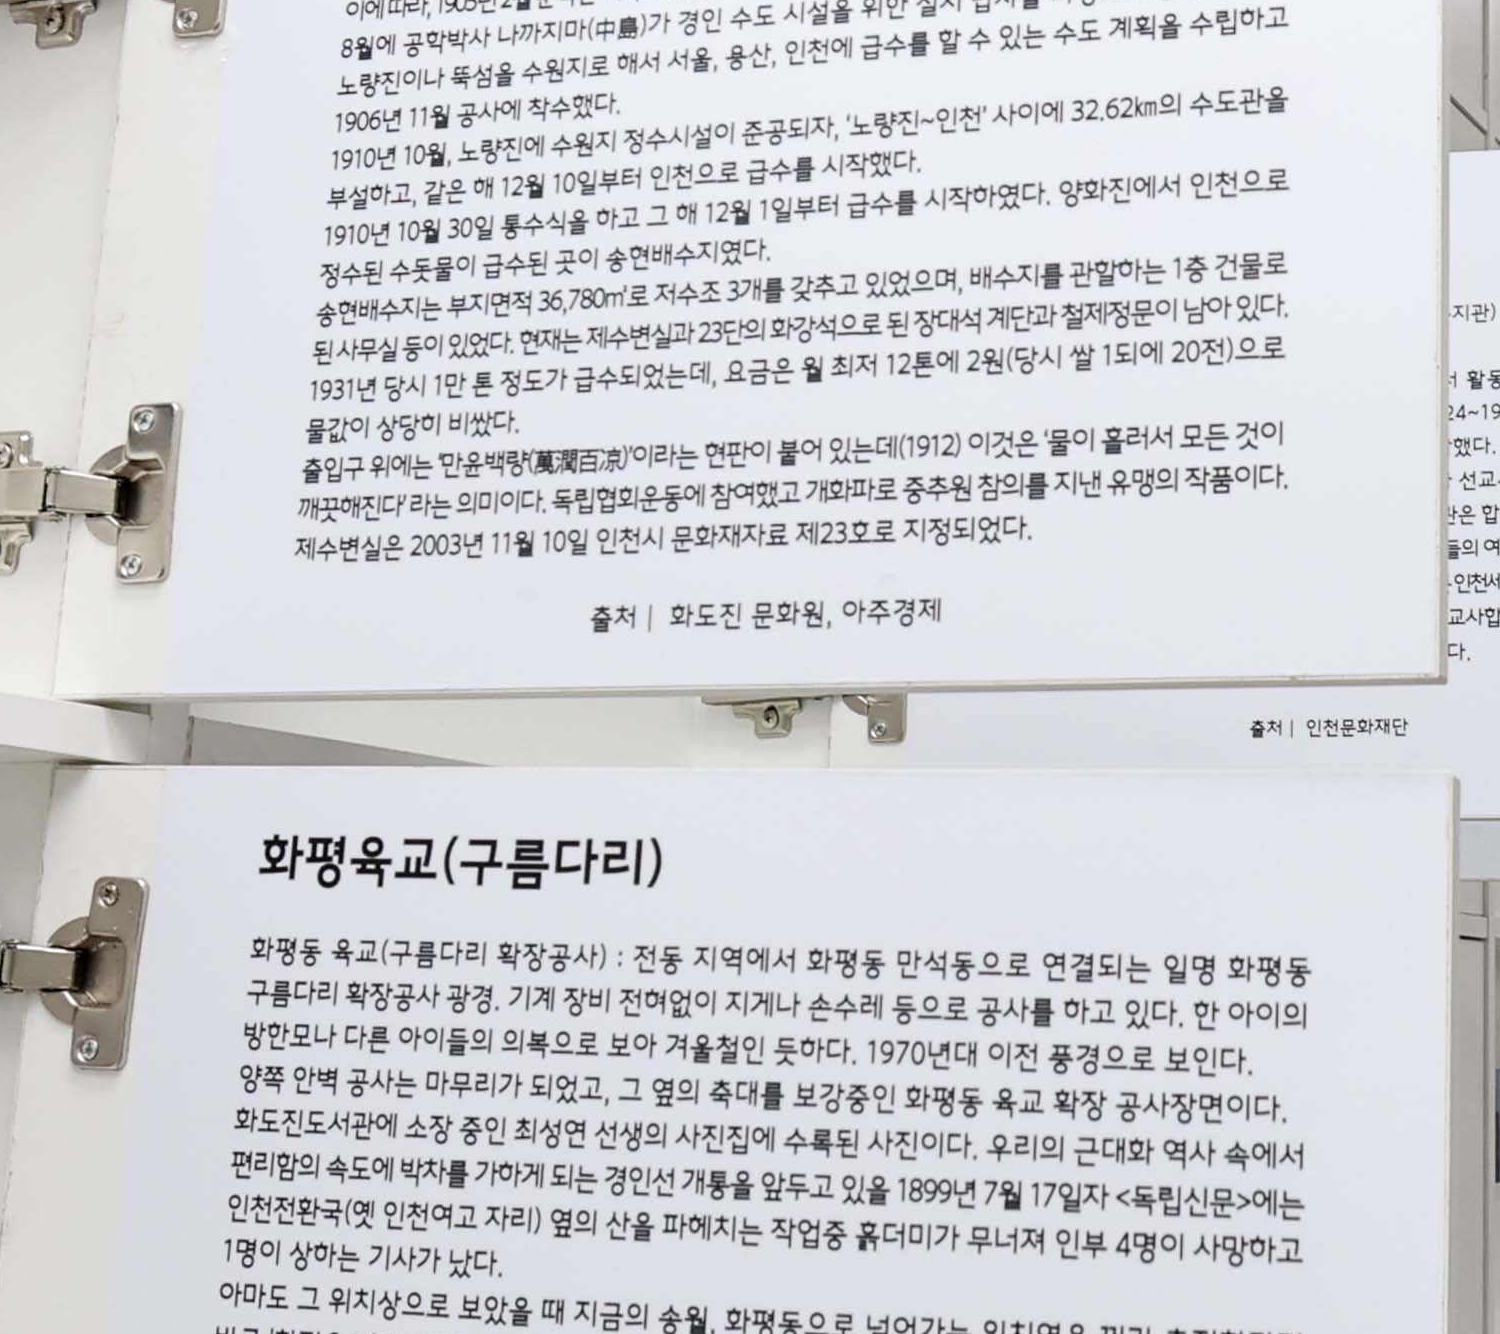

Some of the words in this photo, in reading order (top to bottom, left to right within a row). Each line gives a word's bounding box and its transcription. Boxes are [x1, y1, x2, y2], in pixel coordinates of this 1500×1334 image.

[336, 108, 402, 133] 1906년
[410, 104, 450, 130] 11월
[457, 99, 521, 128] 공사에
[528, 92, 620, 122] 착수했다.
[1449, 303, 1497, 323] 지관)
[305, 416, 369, 445] 물값이
[376, 413, 441, 442] 상당히
[449, 411, 519, 437] 비쌌다.
[1449, 437, 1497, 458] 했다.
[295, 534, 404, 562] 제수변실은
[410, 532, 483, 559] 2003년
[492, 531, 534, 558] 11월
[543, 529, 588, 556] 10일
[596, 526, 663, 555] 인천시
[671, 523, 789, 553] 문화재자료
[796, 520, 896, 546] 제23호로
[903, 515, 1032, 547] 지정되었다.
[590, 605, 636, 633] 출처
[670, 603, 741, 630] 화도진
[751, 601, 831, 630] 문화원,
[842, 598, 941, 627] 아주경제
[1250, 719, 1282, 739] 출처
[1306, 718, 1408, 738] 인천문화재단
[259, 834, 662, 890] 화평육교(구름다리)
[250, 936, 322, 967] 화평동
[331, 938, 487, 969] 육교(구름다리
[497, 941, 606, 973] 확장공사)
[633, 945, 683, 975] 전동
[693, 946, 796, 976] 지역에서
[806, 948, 886, 980] 화평동
[897, 950, 1031, 981] 만석동으로
[1043, 952, 1152, 984] 연결되는
[1164, 954, 1215, 986] 일명
[1228, 955, 1312, 988] 화평동
[247, 980, 338, 1008] 구름다리
[345, 981, 441, 1012] 확장공사
[446, 984, 499, 1015] 광경.
[509, 986, 555, 1012] 기계
[563, 987, 610, 1017] 장비
[619, 989, 716, 1018] 전혀없이
[725, 991, 801, 1018] 지게나
[808, 993, 883, 1022] 손수레
[892, 995, 968, 1025] 등으로
[977, 997, 1055, 1028] 공사를
[1064, 998, 1116, 1025] 하고
[1125, 1000, 1183, 1030] 있다.
[1193, 1000, 1220, 1031] 한
[1228, 1001, 1307, 1030] 아이의
[244, 1022, 337, 1051] 방한모나
[344, 1025, 390, 1054] 다른
[399, 1027, 493, 1056] 아이들의
[501, 1029, 599, 1059] 의복으로
[607, 1033, 657, 1059] 보아
[665, 1034, 764, 1065] 겨울철인
[774, 1037, 856, 1066] 듯하다.
[868, 1040, 977, 1070] 1970년대
[988, 1043, 1038, 1073] 이전
[1048, 1044, 1155, 1075] 풍경으로
[1164, 1047, 1252, 1077] 보인다.
[224, 1238, 281, 1269] 1명이
[289, 1241, 360, 1273] 상하는
[368, 1245, 441, 1274] 기사가
[449, 1249, 502, 1279] 났다.
